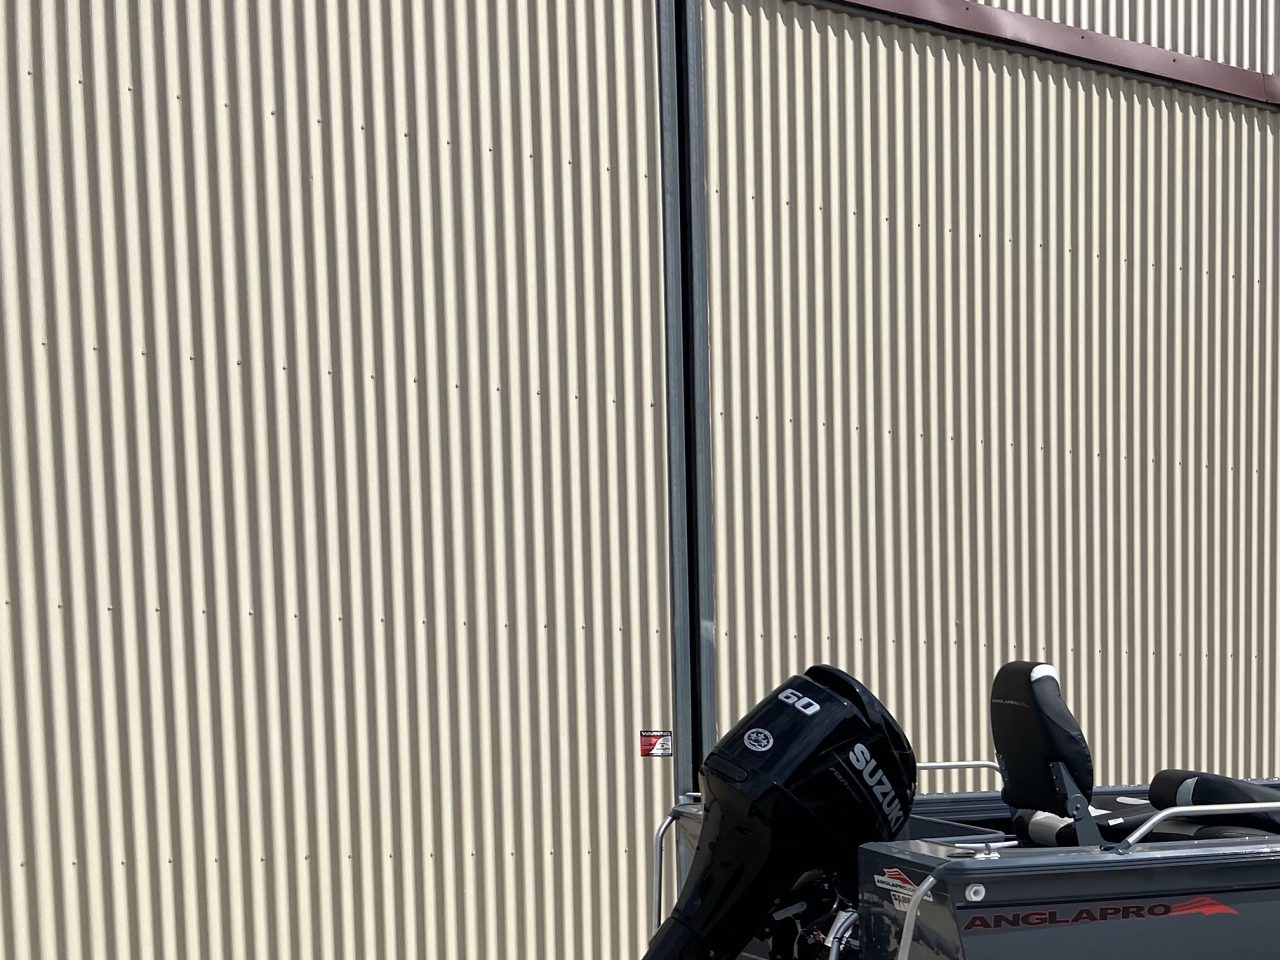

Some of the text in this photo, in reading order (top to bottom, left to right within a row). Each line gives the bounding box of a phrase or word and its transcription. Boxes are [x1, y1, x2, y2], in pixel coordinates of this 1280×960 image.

[777, 688, 820, 714] 60
[849, 743, 904, 832] SUZUKI
[963, 904, 1172, 931] ANGLAPRO
